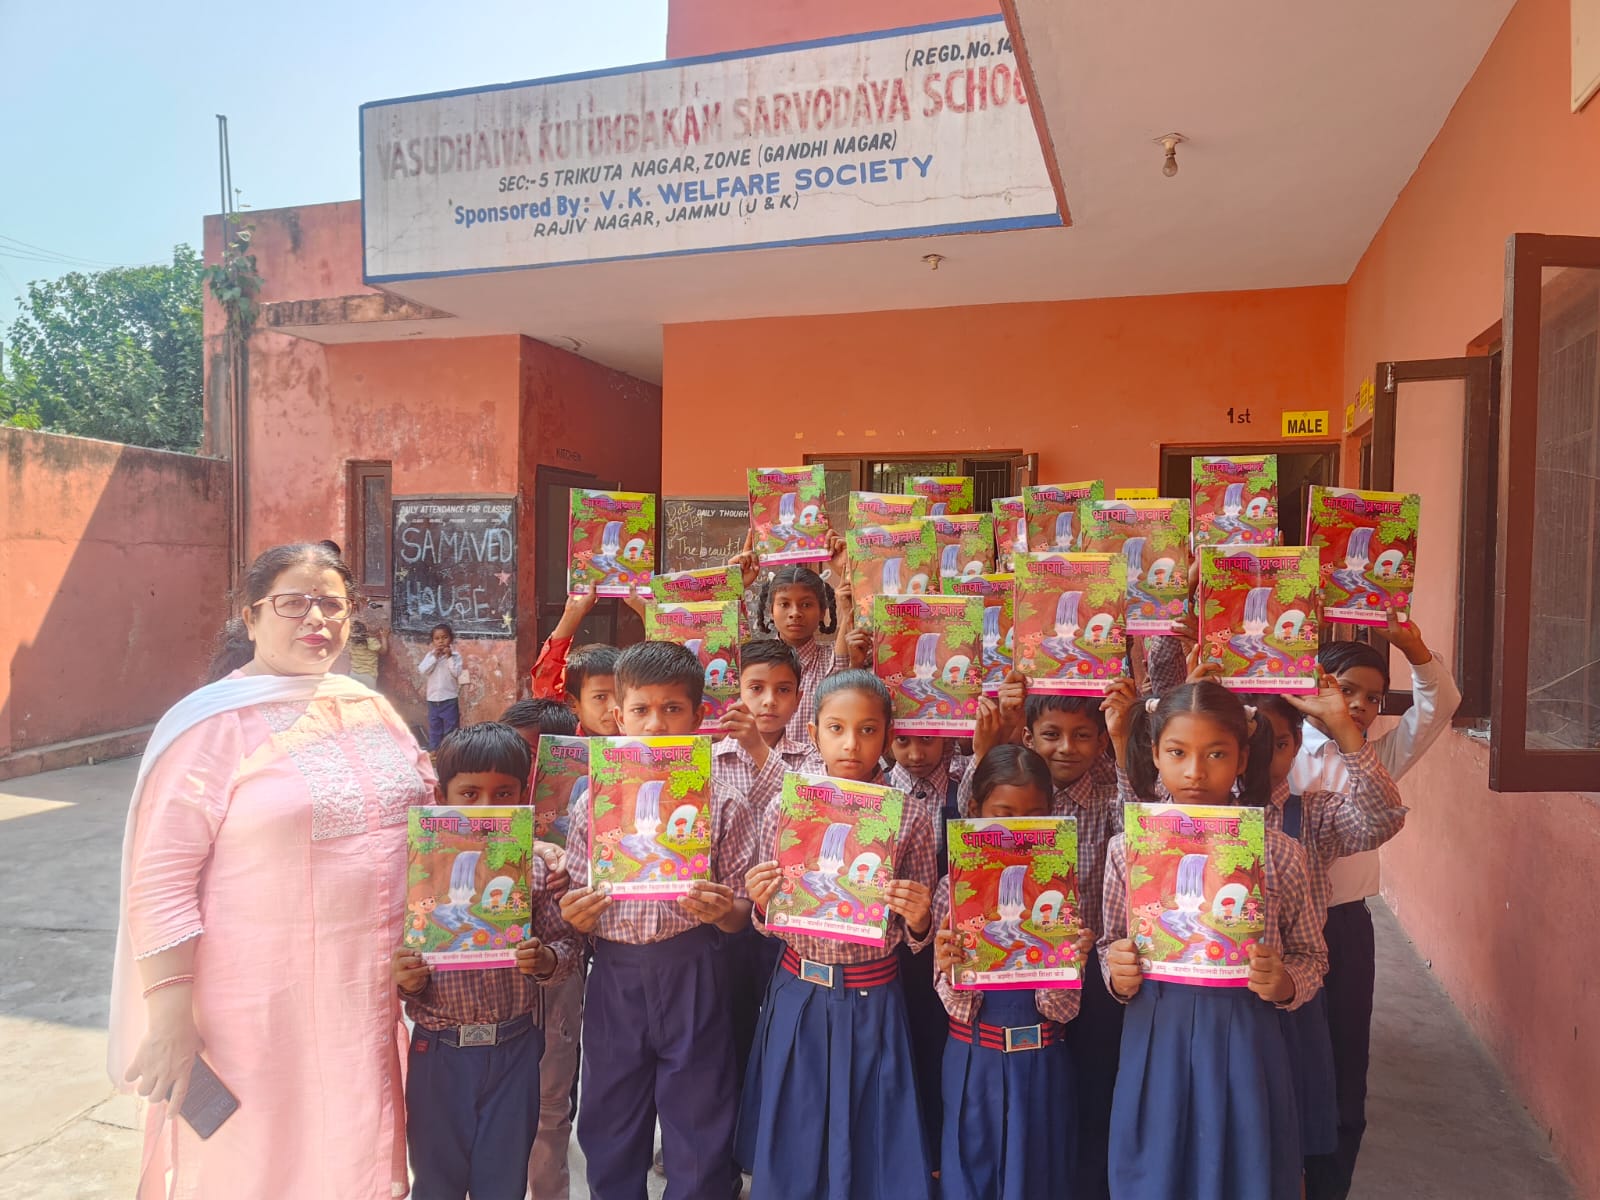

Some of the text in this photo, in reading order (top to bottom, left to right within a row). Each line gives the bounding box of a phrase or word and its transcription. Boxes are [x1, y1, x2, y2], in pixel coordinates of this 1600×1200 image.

[376, 128, 532, 180] VASUDHAIVA
[539, 103, 722, 162] KUTUMBAKAM
[733, 77, 910, 138] SARVODAYA
[554, 164, 622, 186] TRIKUTA
[631, 155, 700, 177] NAGAR,
[705, 148, 751, 170] ZONE
[758, 139, 828, 168] (GANDHI
[833, 129, 898, 155] NAGAR)
[455, 197, 551, 228] Sponsored
[657, 172, 780, 206] WELFARE
[794, 154, 933, 191] SOCIETY
[533, 217, 587, 237] RAJIV
[594, 211, 660, 232] NAGAR,
[665, 201, 731, 223] JAMMU
[764, 196, 775, 211] &
[780, 191, 799, 210] K)
[1227, 407, 1251, 424] 1st
[1287, 418, 1322, 434] MALE
[420, 505, 465, 514] ATTENDANCE
[466, 505, 481, 514] FOR
[482, 505, 512, 514] CLASSES
[401, 527, 513, 564] SAMAVED
